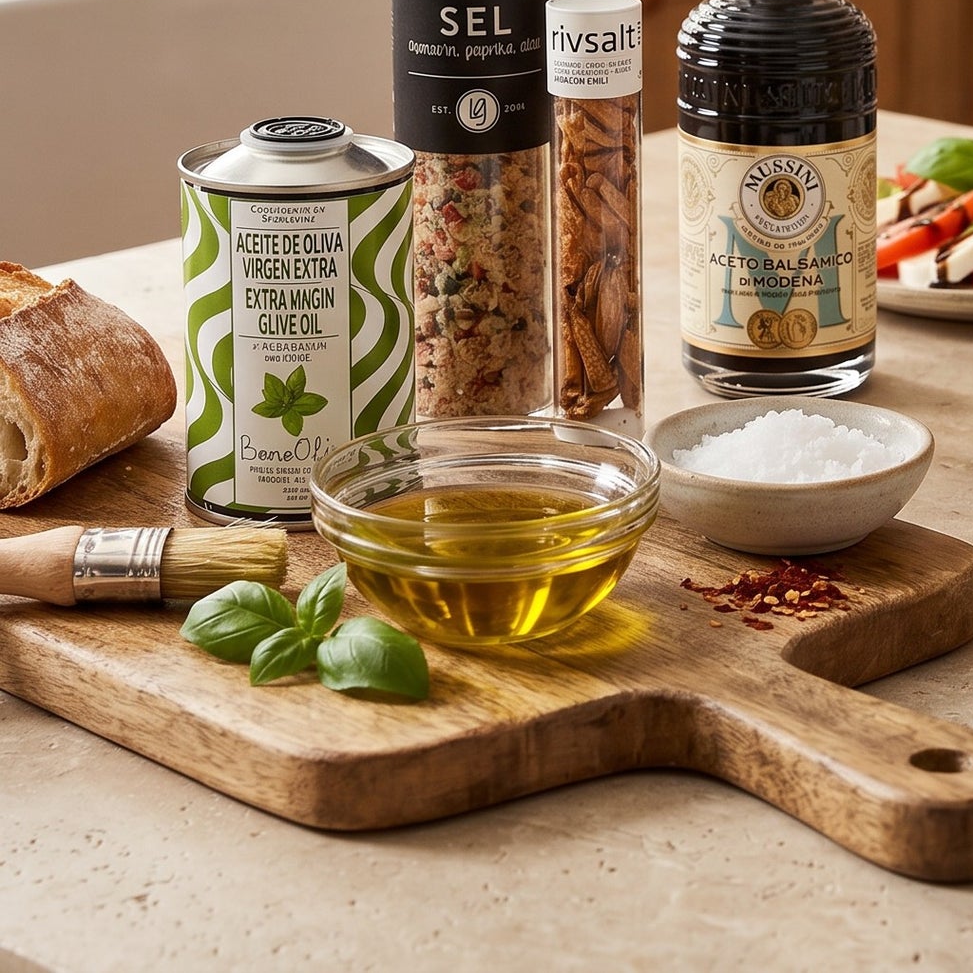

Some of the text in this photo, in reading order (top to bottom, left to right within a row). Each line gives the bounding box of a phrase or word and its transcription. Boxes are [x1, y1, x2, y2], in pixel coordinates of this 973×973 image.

[440, 6, 512, 37] SEL
[552, 23, 635, 53] rivsalt
[431, 105, 452, 114] EST.
[744, 159, 819, 193] MUSSINI
[236, 232, 344, 255] ACEITE DE OLIVA
[242, 257, 338, 280] VIRGEN EXTRA
[710, 253, 758, 270] ACETO
[763, 251, 853, 271] BALSAMICO
[739, 274, 824, 288] DI MODENA
[245, 287, 287, 310] EXTRA
[300, 312, 322, 335] OIL
